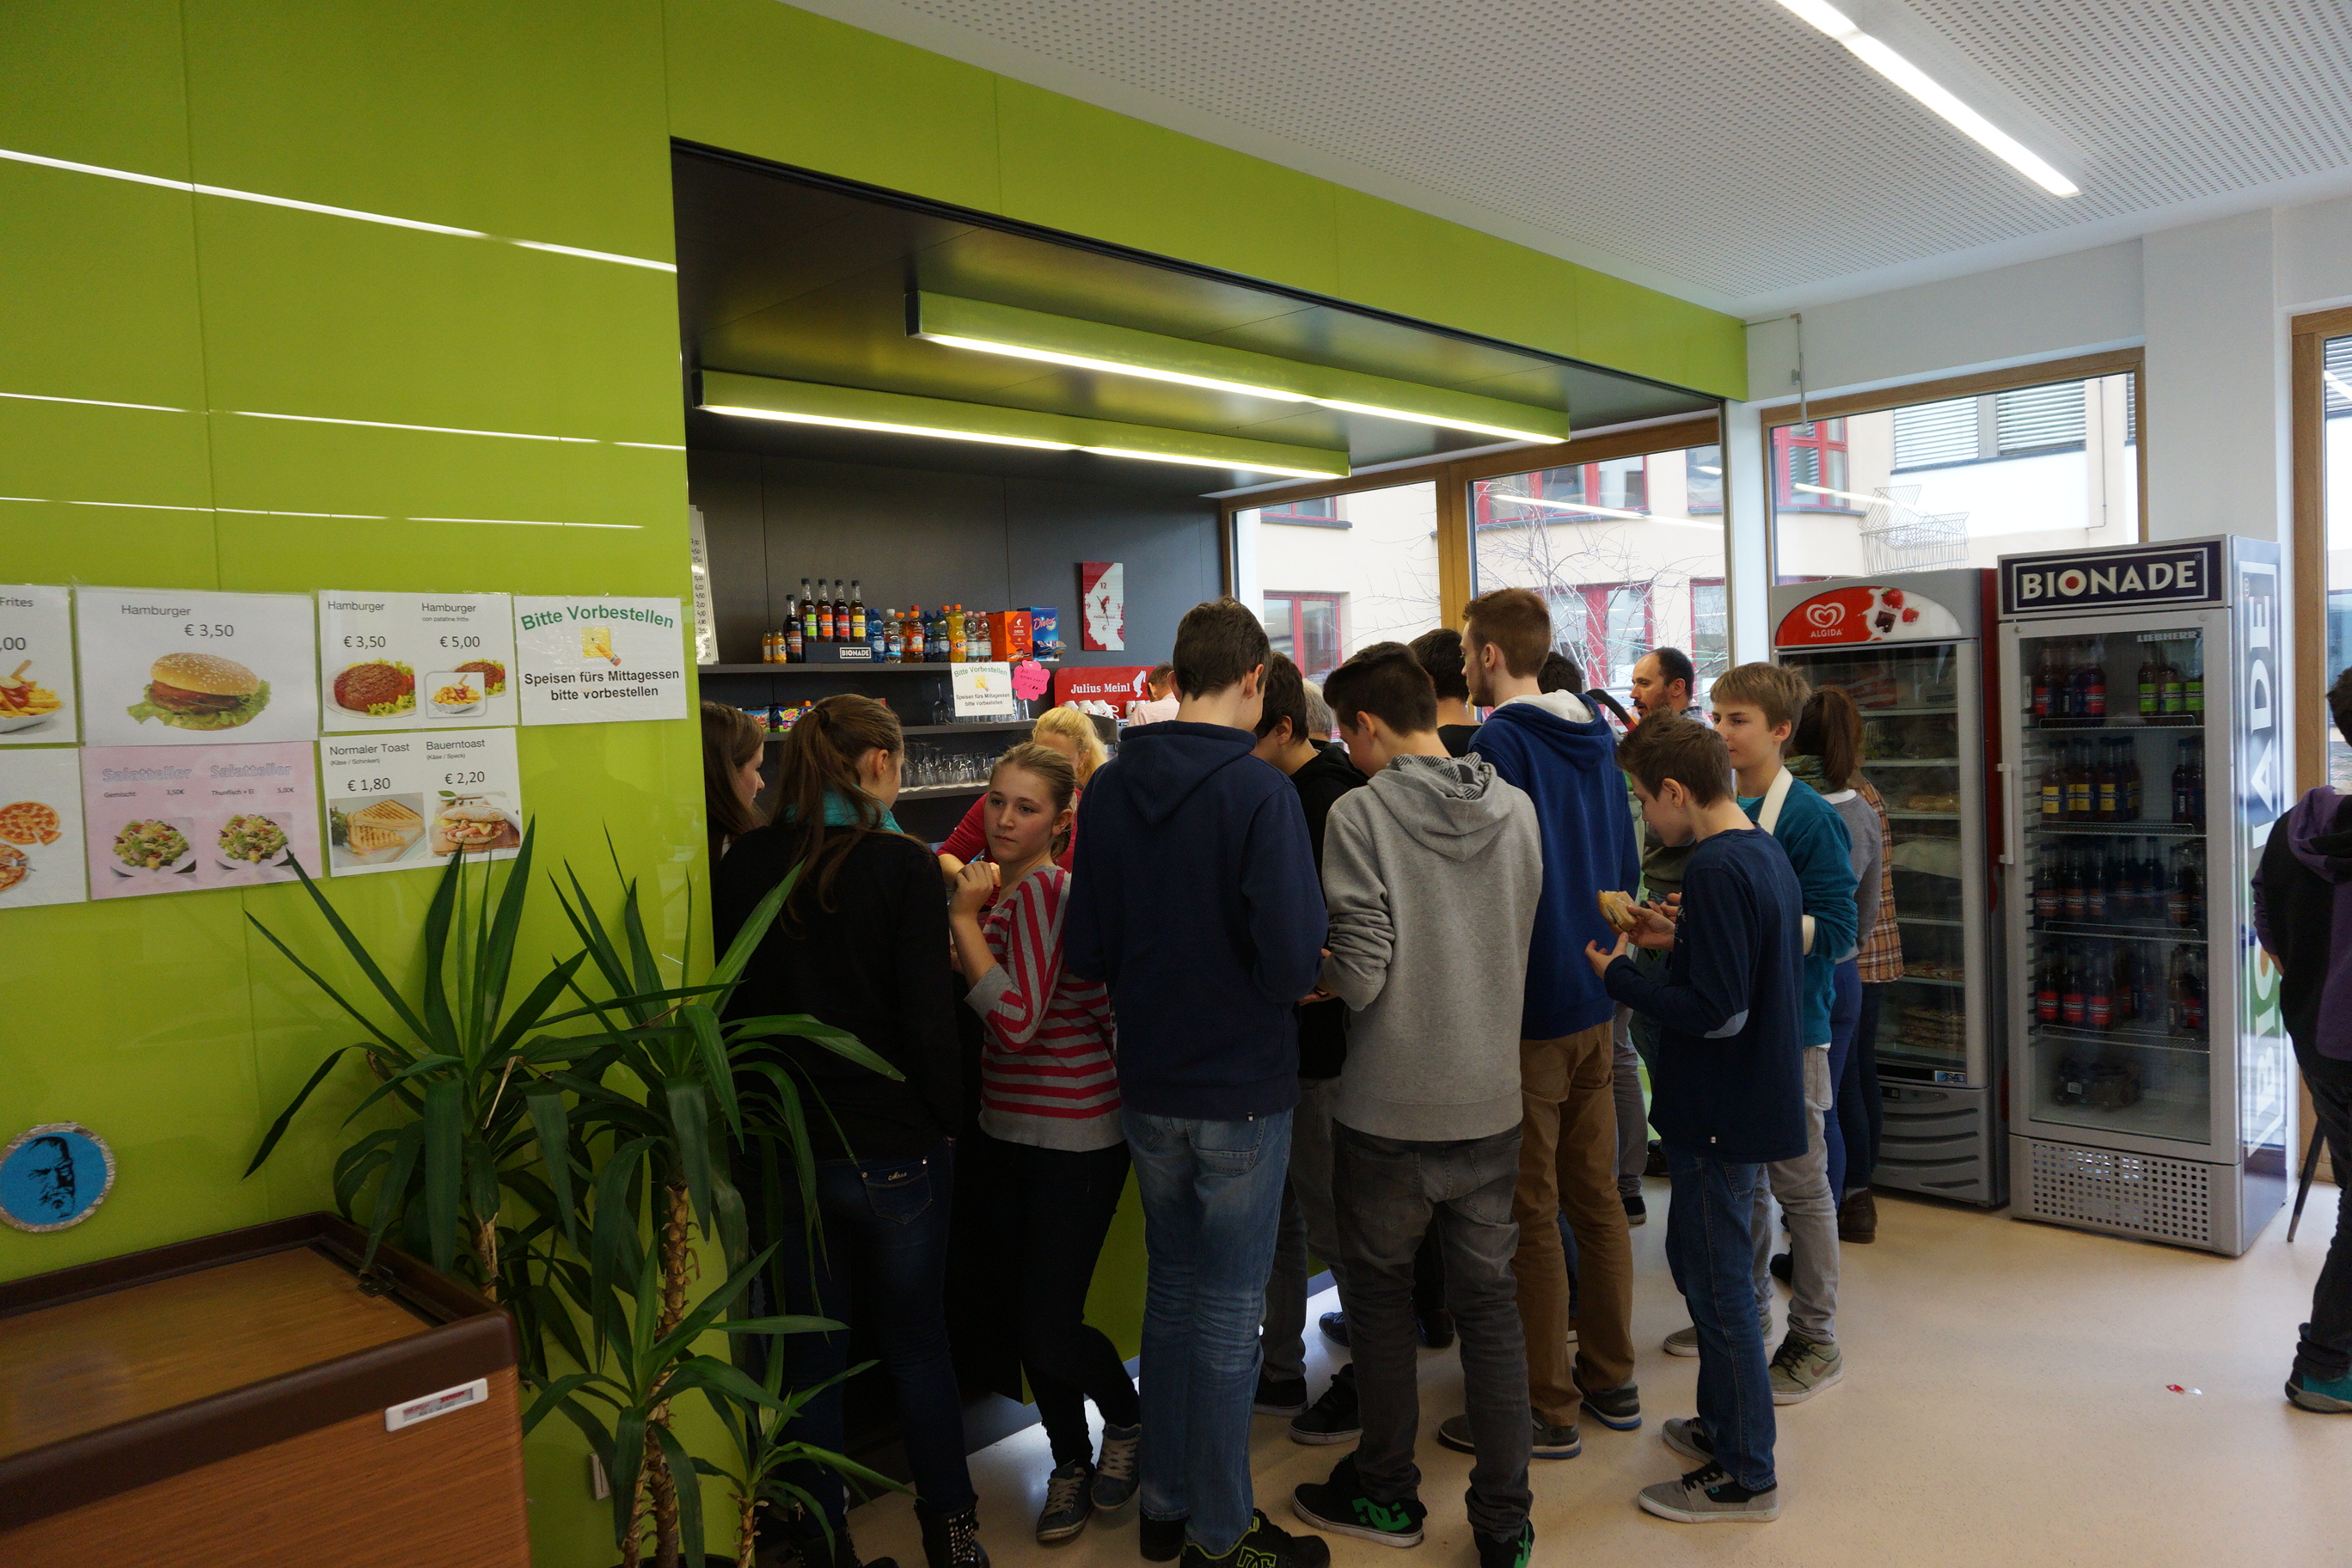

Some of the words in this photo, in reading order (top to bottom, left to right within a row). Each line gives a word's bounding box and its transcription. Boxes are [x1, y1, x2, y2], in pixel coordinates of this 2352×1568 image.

[2021, 560, 2197, 600] BIONADE
[121, 604, 192, 618] Hamburger
[328, 601, 386, 613] Hamburger
[421, 603, 476, 615] Hamburger
[520, 610, 563, 631] Bitte
[566, 604, 674, 628] Vorbestellen
[184, 623, 194, 637] €
[199, 623, 234, 639] 3,50
[1810, 629, 1843, 638] ALGIDA
[2137, 630, 2196, 643] LIEBHERR
[343, 636, 352, 648] €
[356, 636, 386, 649] 3,50
[439, 636, 449, 648] €
[451, 636, 481, 649] 5,00
[953, 668, 969, 677] Bitte
[969, 666, 1008, 676] Vorbestellen
[524, 672, 576, 687] Speisen
[579, 671, 604, 683] fürs
[608, 670, 680, 684] Mittagessen
[550, 689, 579, 701] bitte
[583, 686, 658, 700] vorbestellen
[1070, 683, 1101, 694] Julius
[1103, 683, 1130, 693] Meinl
[329, 744, 378, 756] Normaler
[380, 743, 410, 753] Toast
[426, 739, 486, 750] Bauerntoast
[102, 765, 193, 783] Salatteller
[210, 763, 292, 779] Salatteller
[347, 780, 357, 792] €
[360, 777, 391, 793] 1,80
[444, 773, 454, 785] €
[457, 771, 486, 786] 2,20
